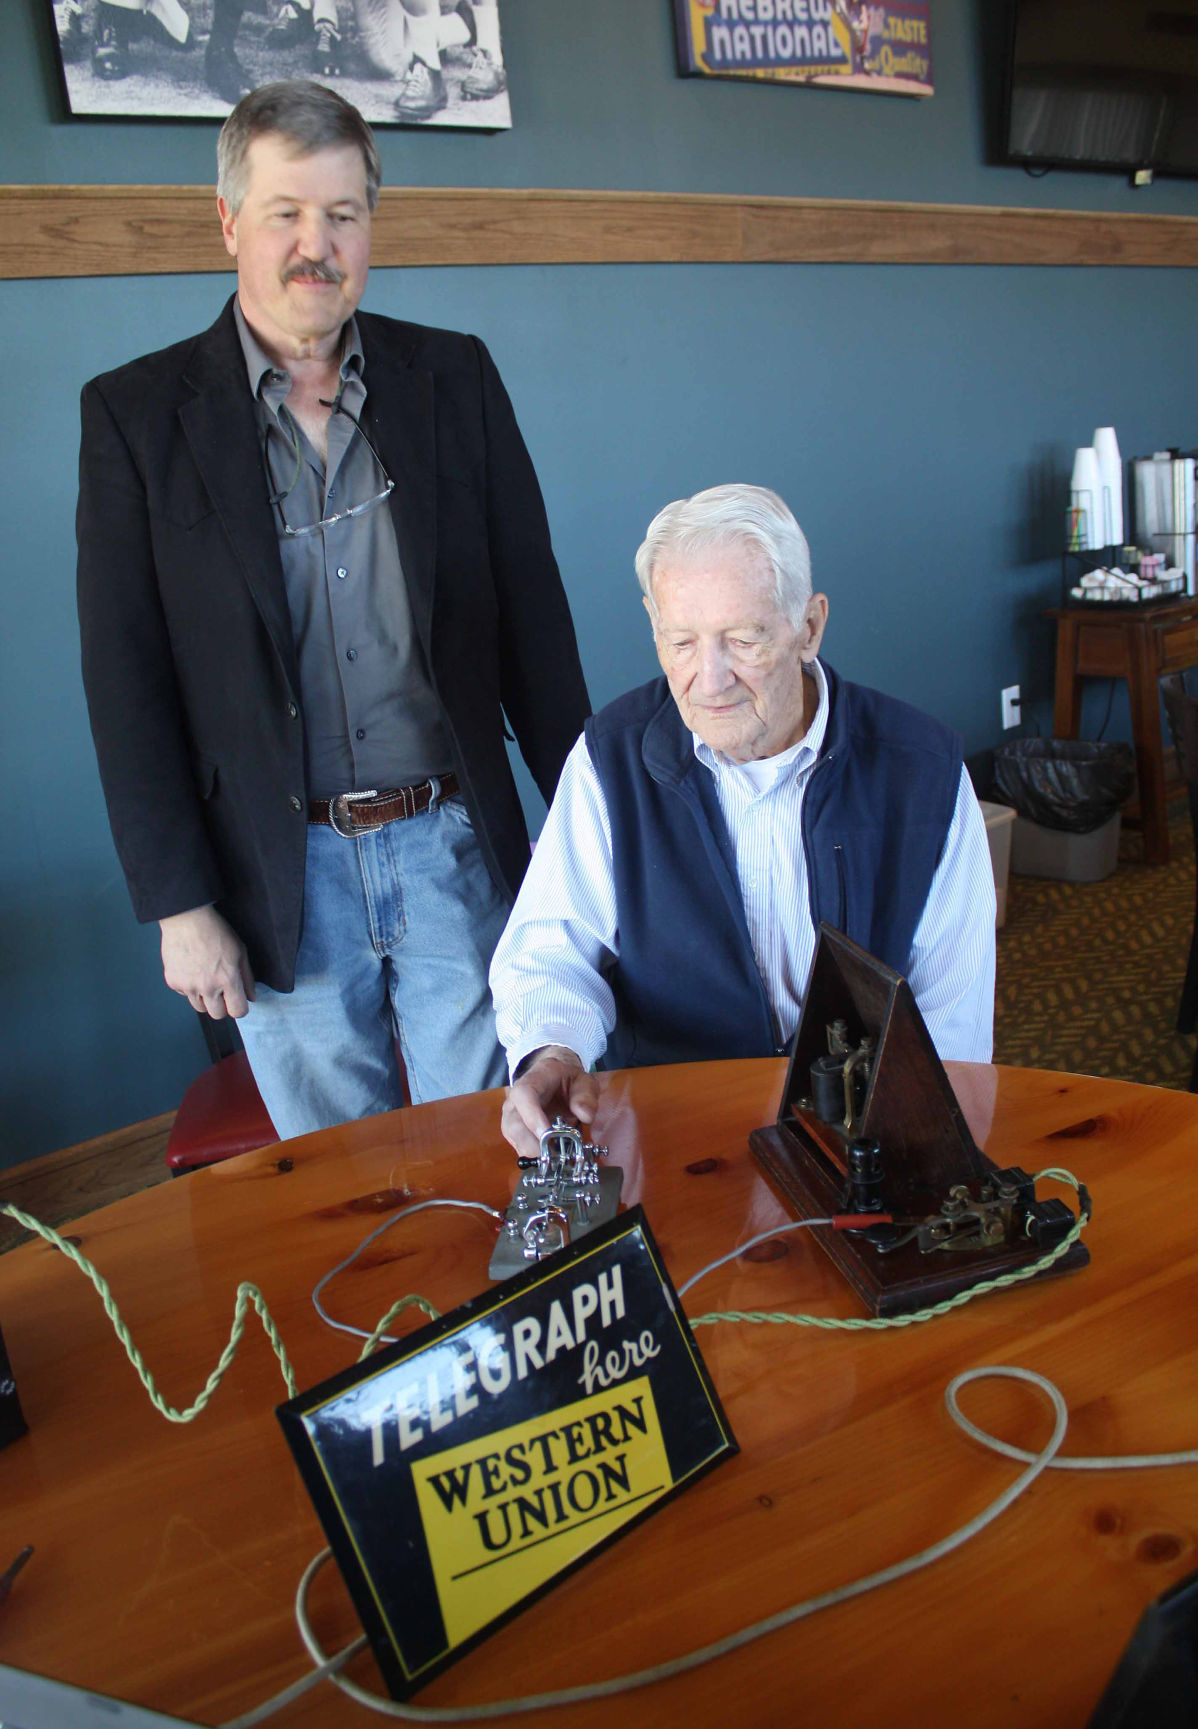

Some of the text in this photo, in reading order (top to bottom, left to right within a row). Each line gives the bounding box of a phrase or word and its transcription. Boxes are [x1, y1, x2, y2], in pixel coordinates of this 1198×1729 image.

[711, 24, 843, 60] NATIONAL
[720, 0, 833, 21] HEBREW
[888, 15, 927, 45] TASTE
[361, 1264, 626, 1468] TELEGRAPH
[578, 1330, 661, 1395] here
[426, 1396, 648, 1514] WESTERN
[473, 1453, 631, 1551] UNION
